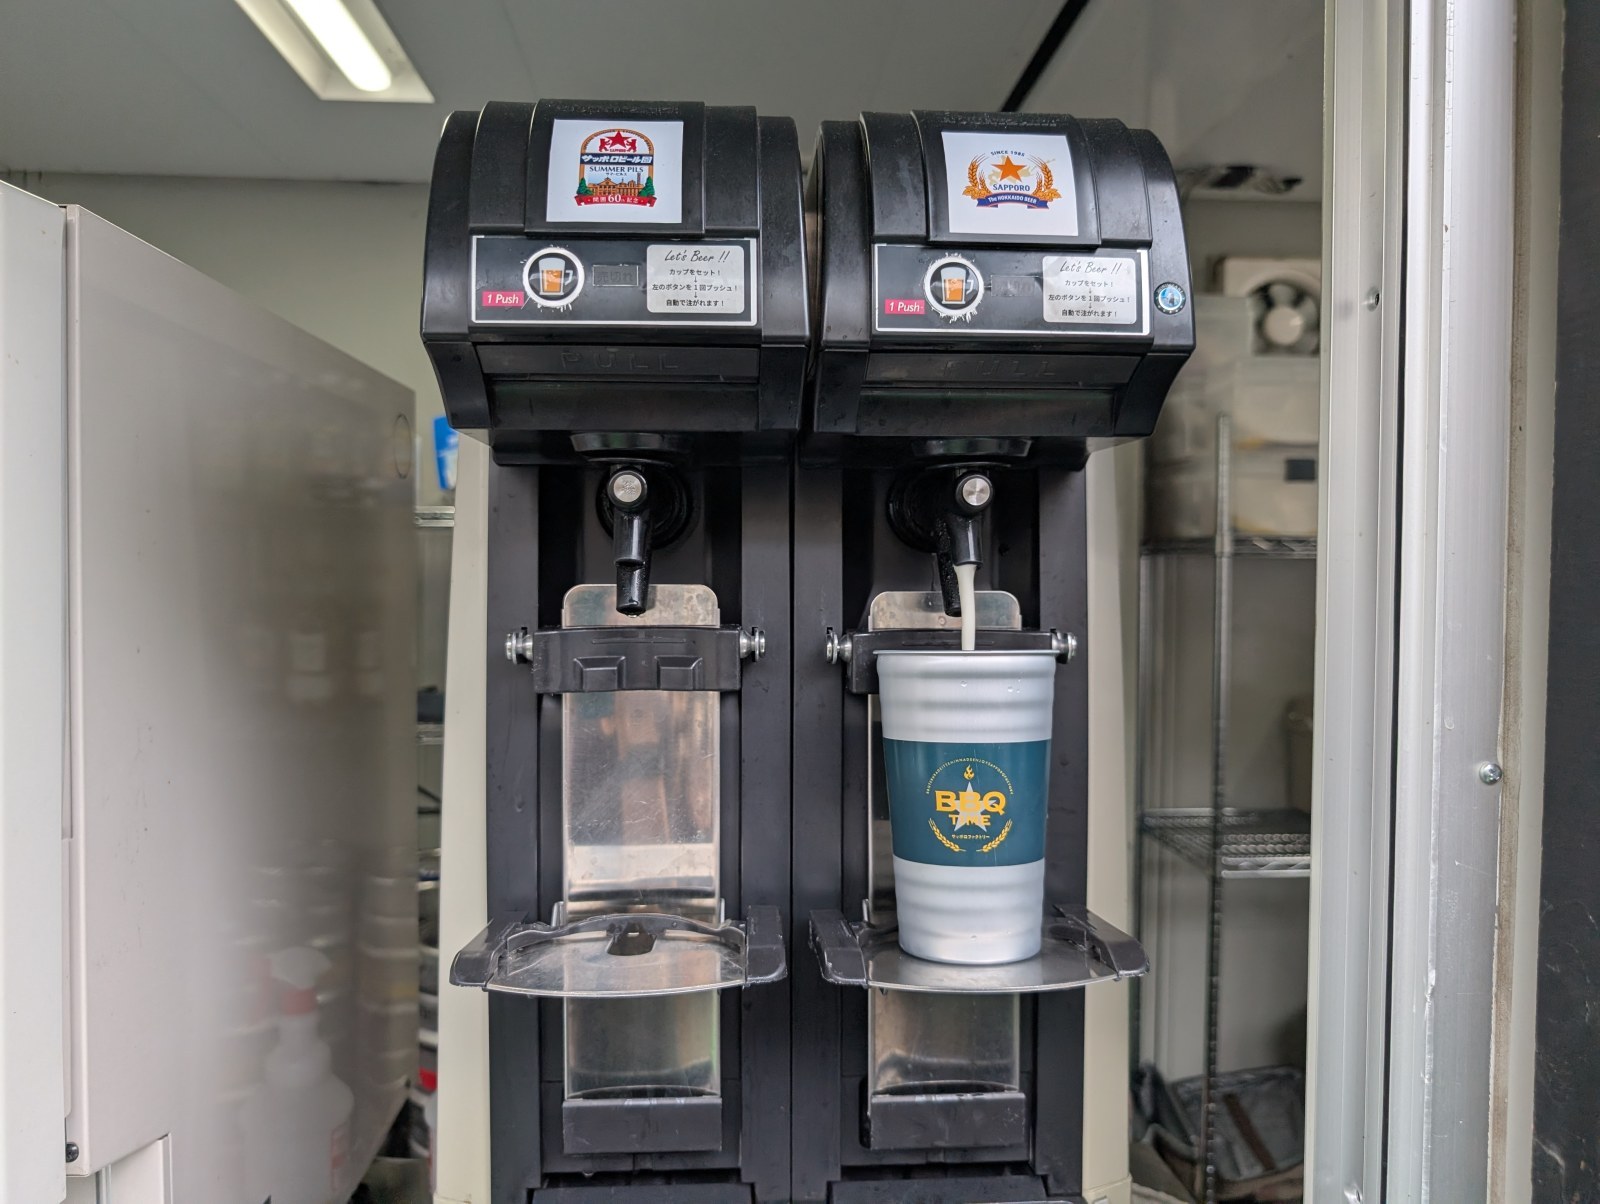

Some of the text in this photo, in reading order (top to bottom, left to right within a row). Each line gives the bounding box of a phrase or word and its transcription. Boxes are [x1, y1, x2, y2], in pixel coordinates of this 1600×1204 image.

[581, 154, 653, 164] サッポロビール園
[664, 250, 730, 262] Let's Beer !!
[1060, 260, 1081, 272] Let's
[1084, 262, 1107, 274] Beer
[487, 294, 519, 304] 1 Push
[666, 299, 724, 307] 自動で注がれます！
[889, 302, 920, 312] 1 Push
[1062, 309, 1117, 318] 自動で注がれます！
[560, 352, 679, 371] PULL
[935, 790, 1006, 816] BBQ
[948, 814, 991, 826] TIME
